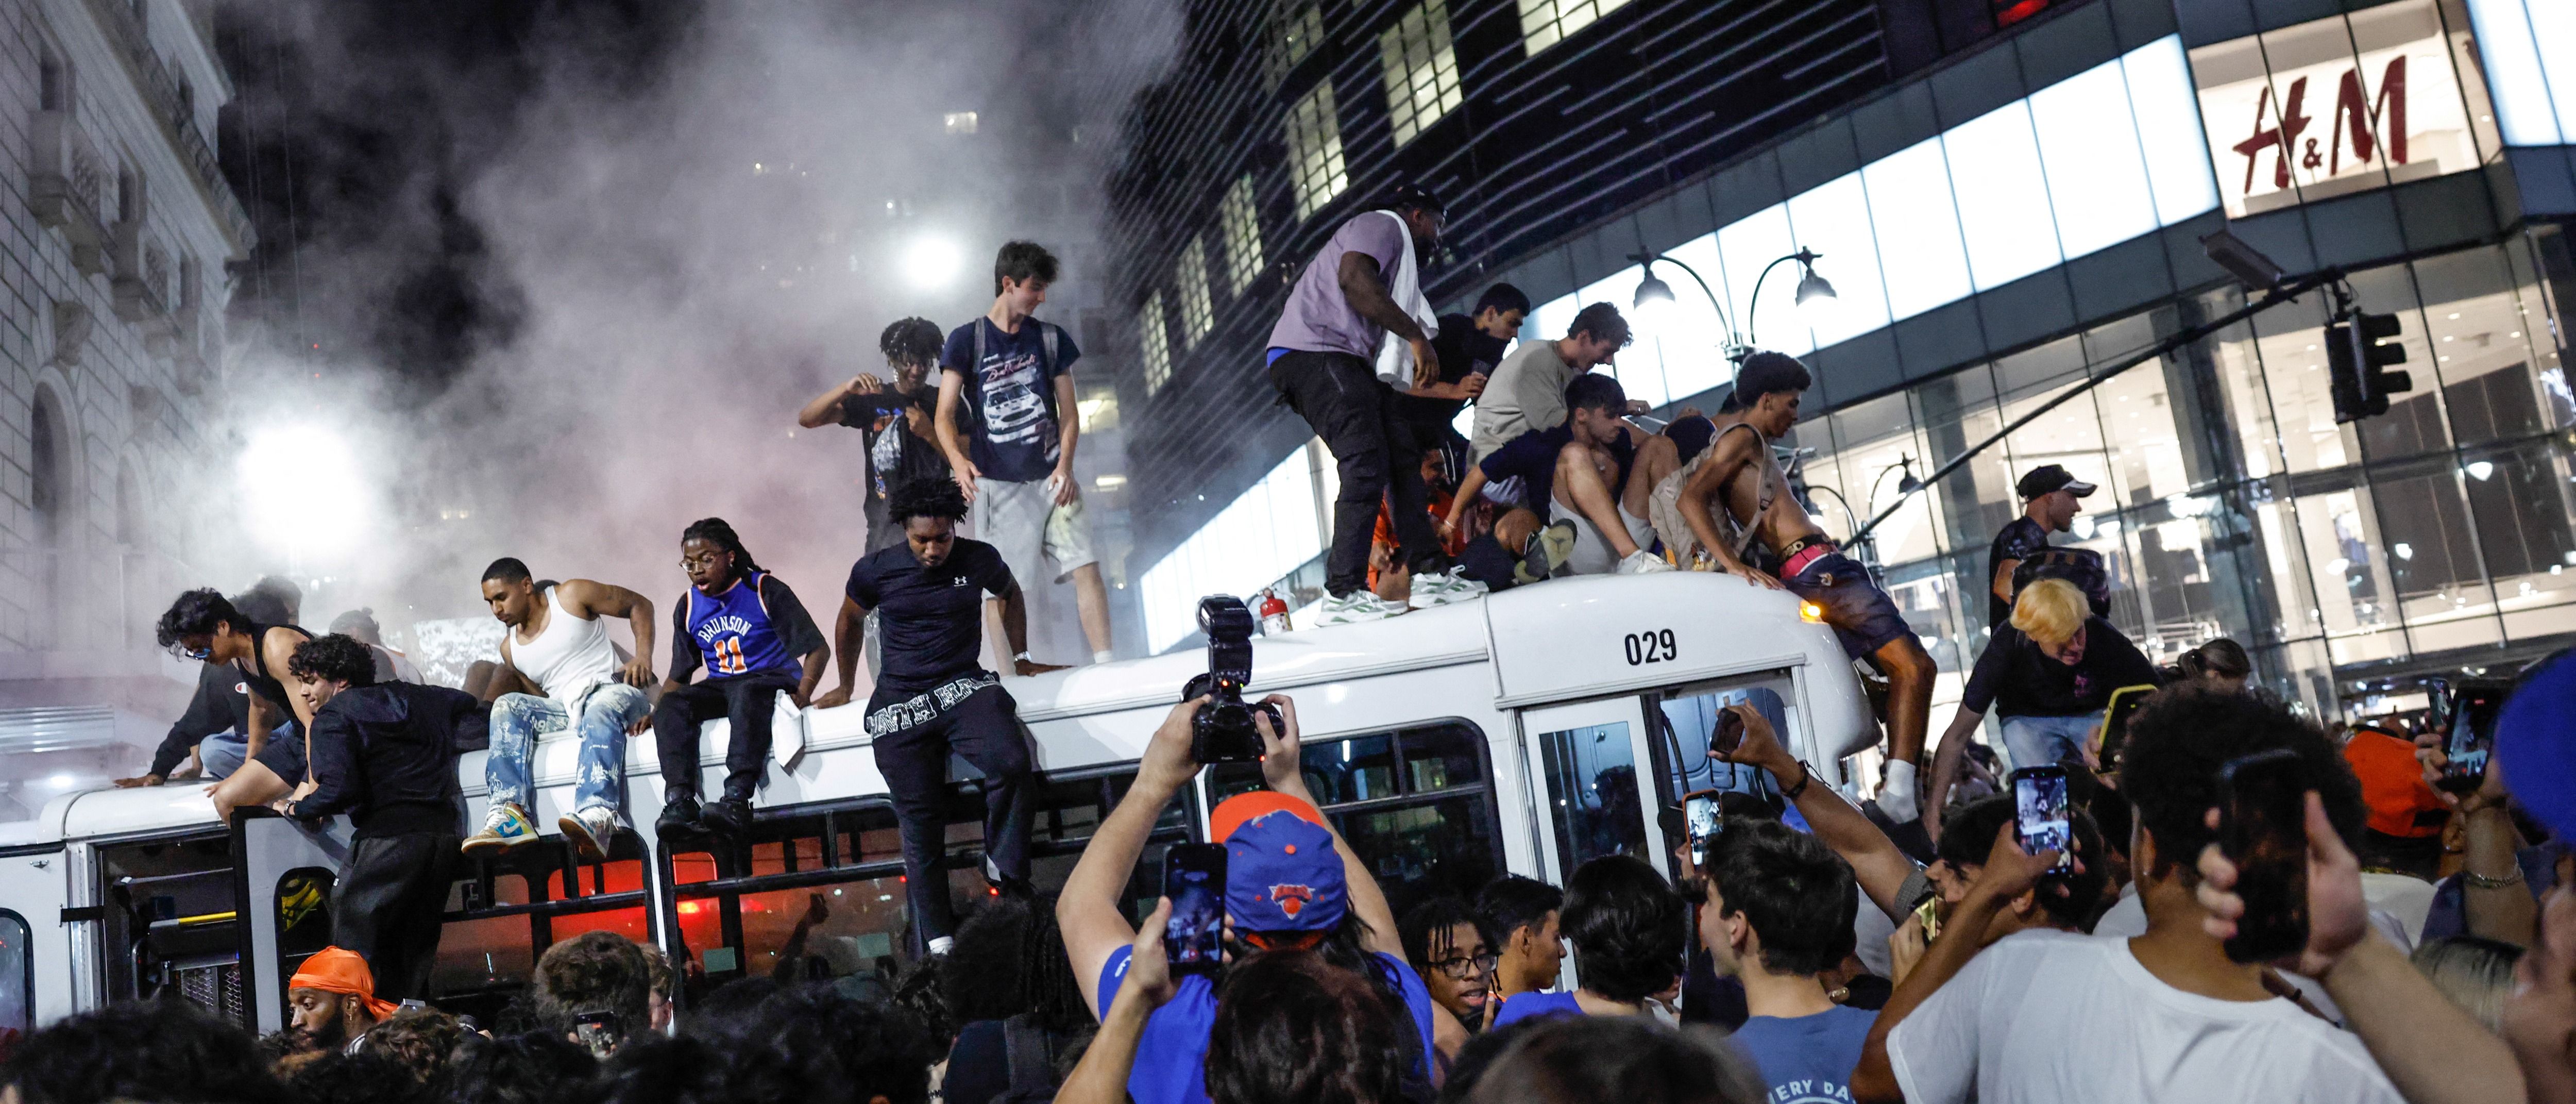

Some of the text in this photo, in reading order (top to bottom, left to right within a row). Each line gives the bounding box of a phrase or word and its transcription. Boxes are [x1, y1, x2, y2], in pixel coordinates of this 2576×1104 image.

[2232, 54, 2407, 194] H&M
[698, 615, 752, 643] BRUNSON
[1624, 628, 1677, 666] 029
[714, 635, 748, 674] 11
[1824, 1081, 1856, 1104] DA
